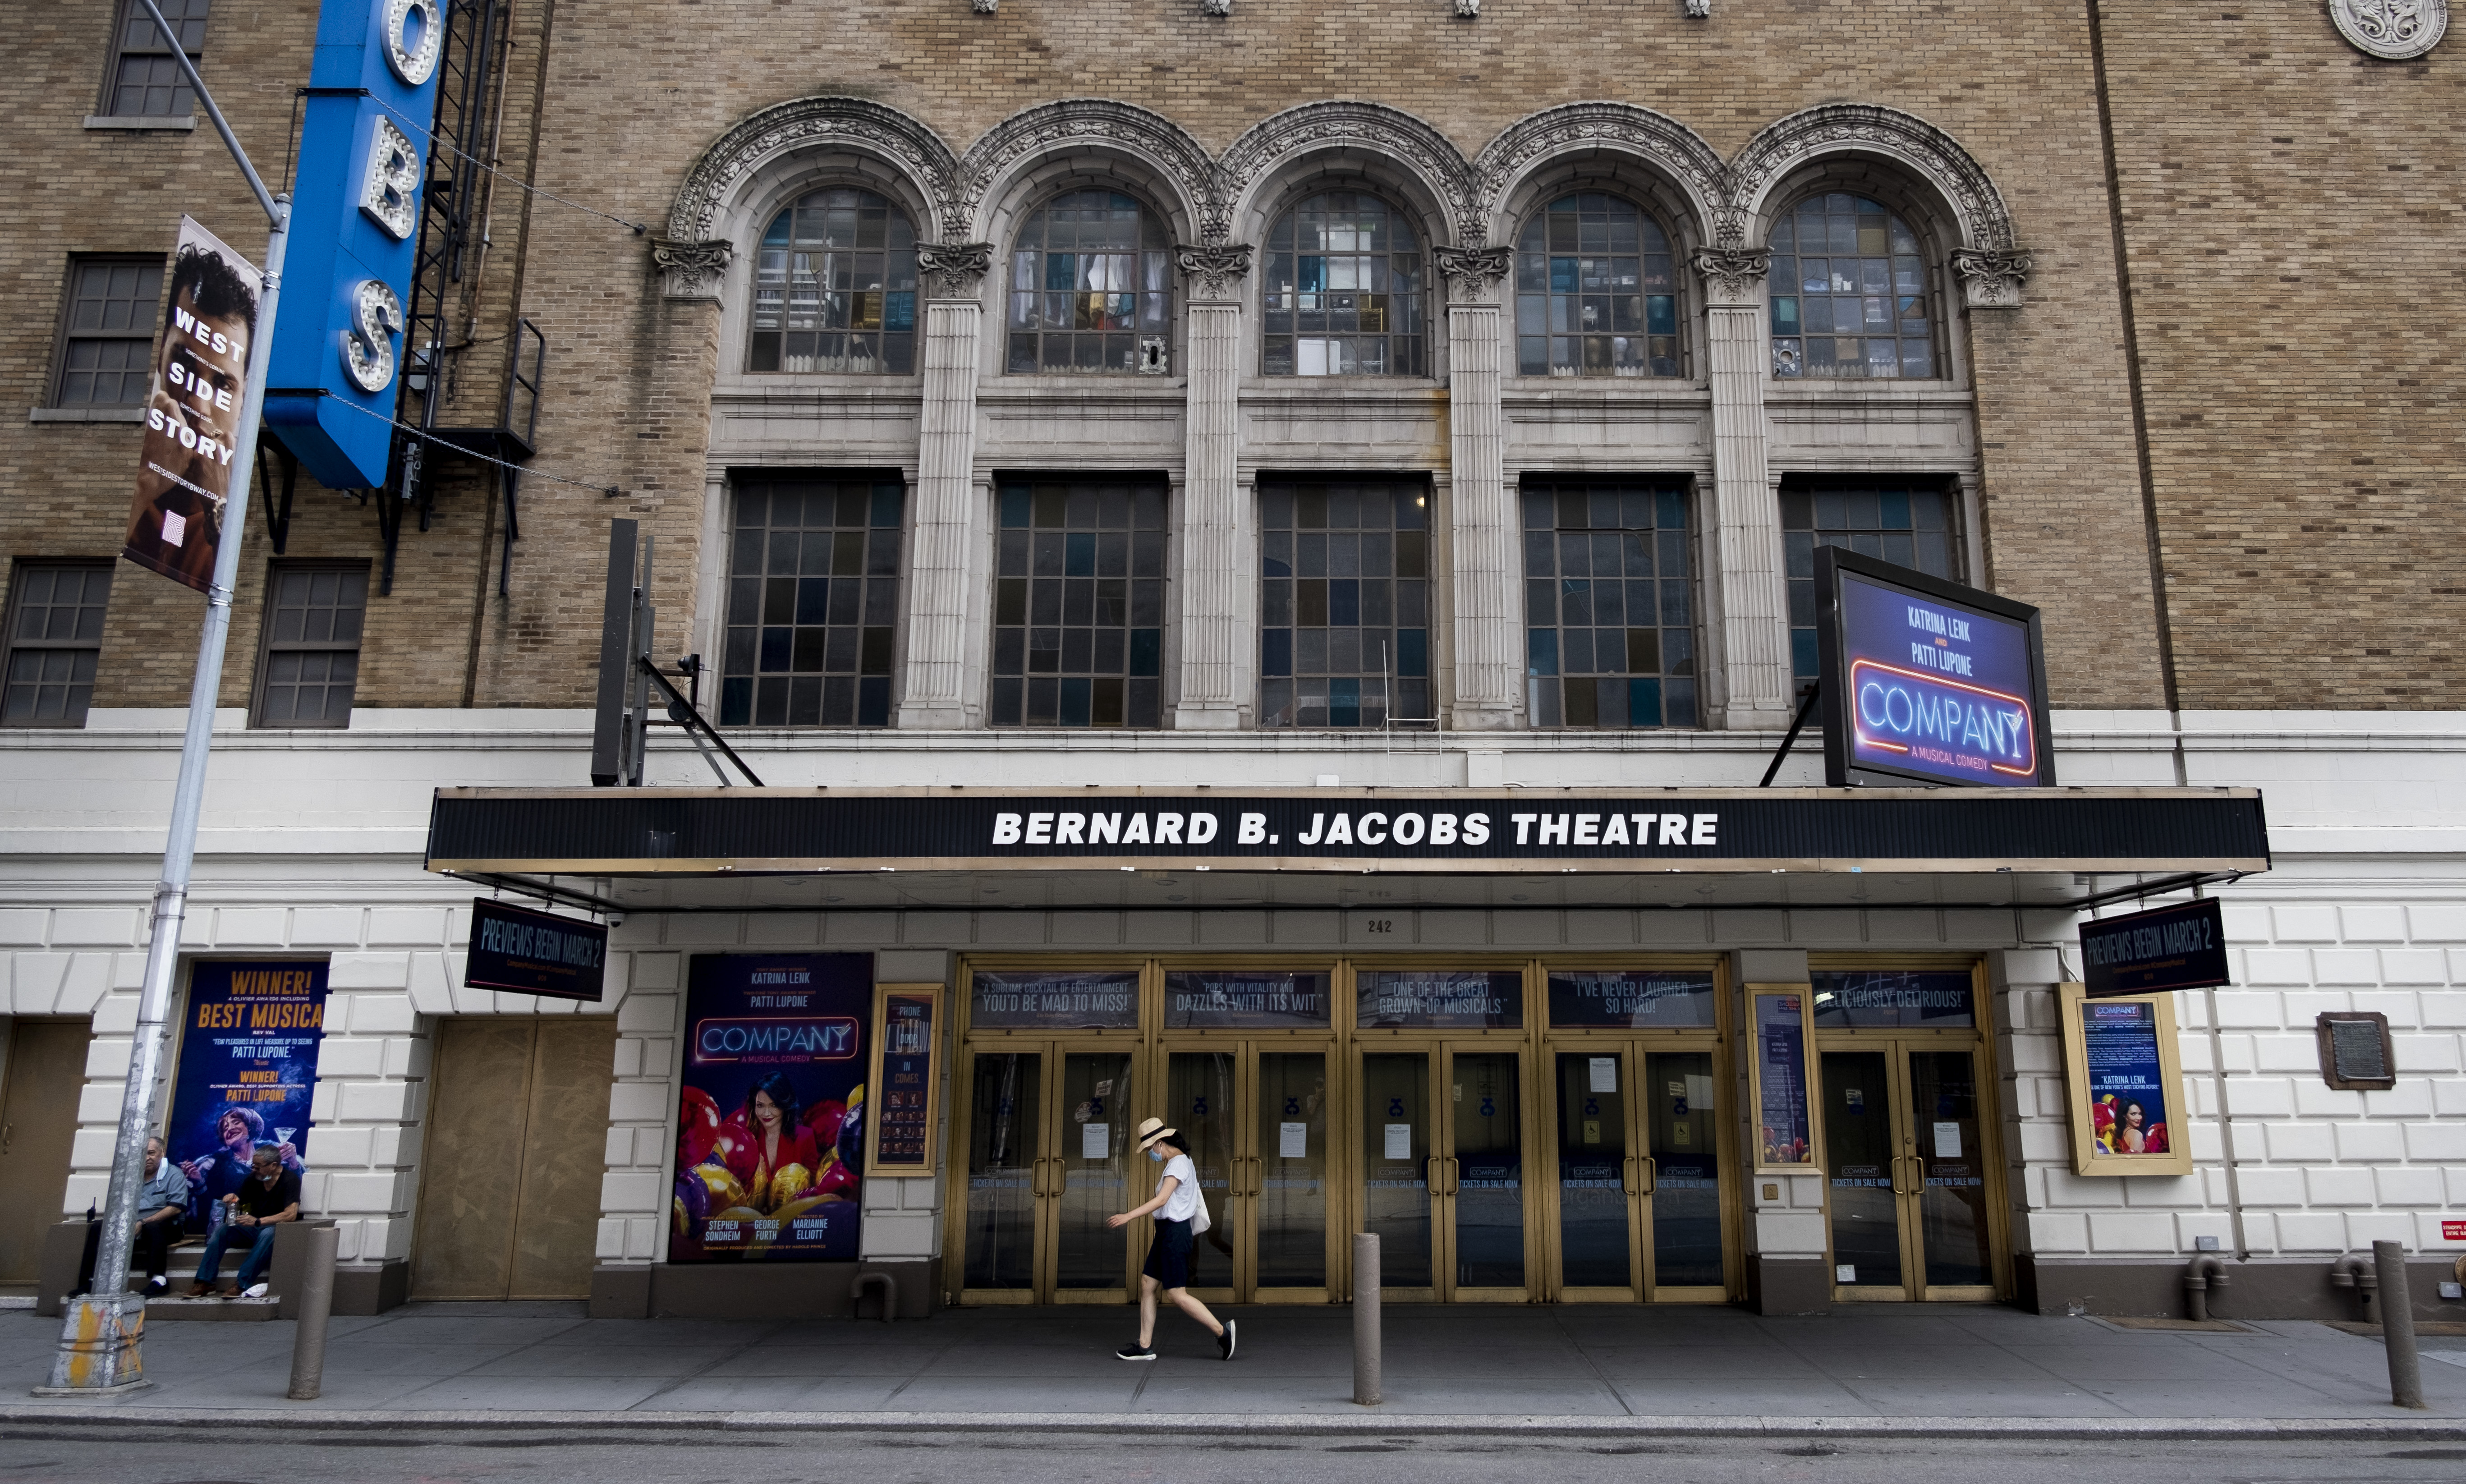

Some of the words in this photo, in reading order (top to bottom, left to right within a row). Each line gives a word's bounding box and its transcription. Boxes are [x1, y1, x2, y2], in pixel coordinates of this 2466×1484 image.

[175, 306, 244, 363] WEST
[169, 362, 232, 412] SIDE
[180, 402, 200, 418] SOMETHING
[201, 414, 213, 424] GOOD.
[149, 409, 234, 466] STORY
[149, 461, 219, 501] WESTSIDESTORYBWAY.COM
[1908, 606, 1946, 635] KATRINA
[1948, 617, 1970, 642] LENK
[1934, 637, 1947, 647] AND
[1911, 642, 1937, 668] PATTI
[1938, 649, 1972, 676] LUPONE
[1861, 682, 2023, 758] COMPANY
[1912, 748, 1918, 757] A
[1919, 748, 1954, 765] MUSICAL
[1956, 754, 1988, 771] COMEDY
[992, 813, 1218, 845] BERNARD
[1238, 813, 1278, 845] B.
[1298, 812, 1490, 845] JACOBS
[1511, 813, 1718, 845] THEATRE
[1368, 920, 1391, 933] 242
[481, 917, 533, 957] PREVIEWS
[534, 928, 561, 961] BEGIN
[562, 933, 593, 966] MARCH
[594, 939, 601, 968] 2
[2086, 931, 2132, 965] PREVIEWS
[2133, 926, 2163, 960] BEGIN
[2163, 919, 2201, 956] MARCH
[2203, 917, 2212, 949] 2
[231, 971, 312, 994] WINNER!
[752, 973, 786, 984] KATRINA
[790, 972, 810, 983] LENK
[992, 983, 1022, 993] SUBLIME
[1025, 983, 1058, 993] COCKTAIL
[1061, 983, 1069, 993] OF
[1072, 983, 1128, 993] ENTERTAINMENT
[1226, 983, 1244, 992] WITH
[1247, 983, 1277, 992] VITALITY
[1280, 983, 1294, 992] AND
[1417, 982, 1430, 997] OF
[1434, 982, 1453, 997] THE
[1457, 982, 1490, 997] GREAT
[1602, 981, 1637, 997] NEVER
[1640, 981, 1688, 997] LAUGHED
[751, 996, 773, 1007] PATTI
[776, 995, 808, 1007] LUPONE
[983, 994, 1018, 1011] YOU'D
[1023, 994, 1037, 1011] BE
[1042, 994, 1069, 1011] MAD
[1074, 994, 1088, 1011] TO
[1093, 994, 1133, 1011] MISS!"
[1176, 994, 1227, 1011] DAZZLES
[1232, 994, 1264, 1011] WITH
[1269, 994, 1287, 1011] ITS
[1379, 998, 1441, 1014] GROWN-UP
[1606, 997, 1620, 1014] SO
[198, 1004, 246, 1028] BEST
[250, 1004, 322, 1028] MUSICA
[899, 1006, 921, 1016] PHONE
[703, 1023, 851, 1051] COMPANY
[900, 1034, 918, 1044] DOOR
[232, 1046, 256, 1058] PATTI
[741, 1056, 747, 1064] A
[749, 1056, 779, 1064] MUSICAL
[781, 1056, 810, 1064] COMEDY
[904, 1061, 911, 1071] IN
[240, 1071, 279, 1083] WINNER!
[895, 1073, 919, 1083] COMES
[2130, 1075, 2146, 1084] LENK
[226, 1089, 250, 1101] PATTI
[253, 1089, 287, 1101] LUPONE
[974, 1179, 995, 1187] TICKETS
[996, 1179, 1003, 1187] ON
[1005, 1179, 1018, 1187] SALE
[1202, 1179, 1215, 1188] SALE
[1217, 1179, 1230, 1188] NOW
[1308, 1180, 1320, 1188] NOW
[1368, 1180, 1388, 1188] TICKETS
[1390, 1180, 1397, 1188] ON
[1399, 1180, 1412, 1188] SALE
[1414, 1180, 1426, 1188] NOW
[1459, 1180, 1480, 1188] TICKETS
[1482, 1180, 1488, 1188] ON
[1490, 1180, 1503, 1188] SALE
[1505, 1180, 1518, 1188] NOW
[1563, 1180, 1584, 1188] TICKETS
[1586, 1180, 1593, 1188] ON
[1594, 1180, 1607, 1188] SALE
[1609, 1180, 1622, 1188] NOW
[1677, 1180, 1685, 1188] ON
[1687, 1180, 1699, 1188] SALE
[1701, 1180, 1714, 1188] NOW
[1832, 1178, 1853, 1187] TICKETS
[1854, 1178, 1861, 1187] ON
[1863, 1178, 1876, 1187] SALE
[1878, 1178, 1891, 1187] NOW
[1945, 1177, 1952, 1186] ON
[1953, 1177, 1966, 1186] SALE
[1968, 1177, 1981, 1186] NOW
[709, 1220, 739, 1230] STEPHEN
[754, 1219, 780, 1229] GEORGE
[793, 1219, 828, 1229] MARIANNE
[705, 1231, 740, 1241] SONDHEIM
[756, 1231, 777, 1240] FURTH
[797, 1230, 823, 1240] ELLIOTT
